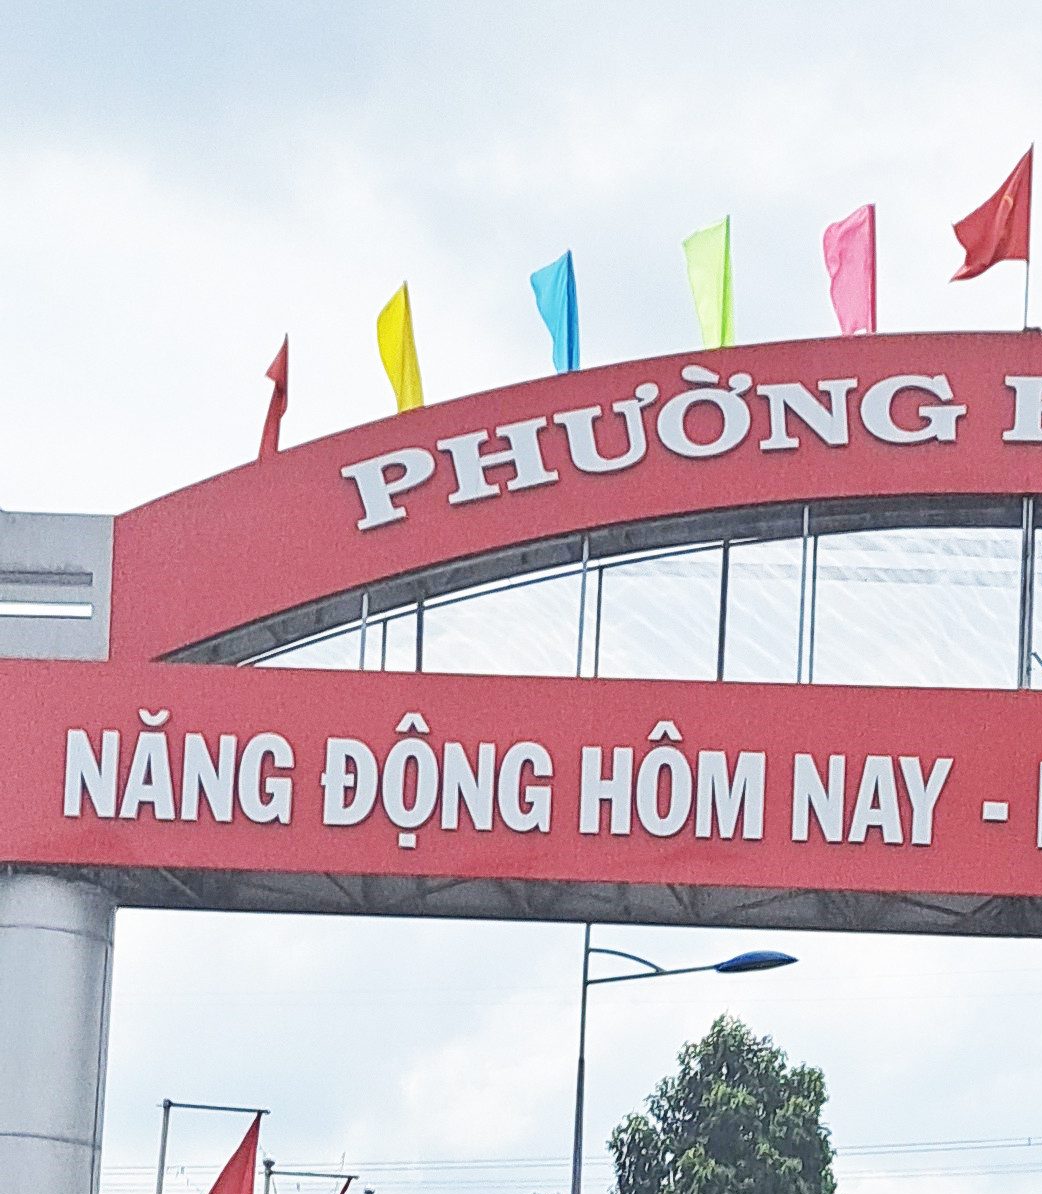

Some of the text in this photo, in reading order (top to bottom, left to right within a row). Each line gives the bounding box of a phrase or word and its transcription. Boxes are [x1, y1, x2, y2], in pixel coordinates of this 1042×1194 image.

[341, 364, 967, 531] PHƯỜNG
[63, 708, 295, 824] NĂNG
[320, 712, 552, 849] ĐỘNG
[579, 720, 766, 840] HÔM
[791, 753, 954, 845] NAY
[981, 801, 1009, 821] -
